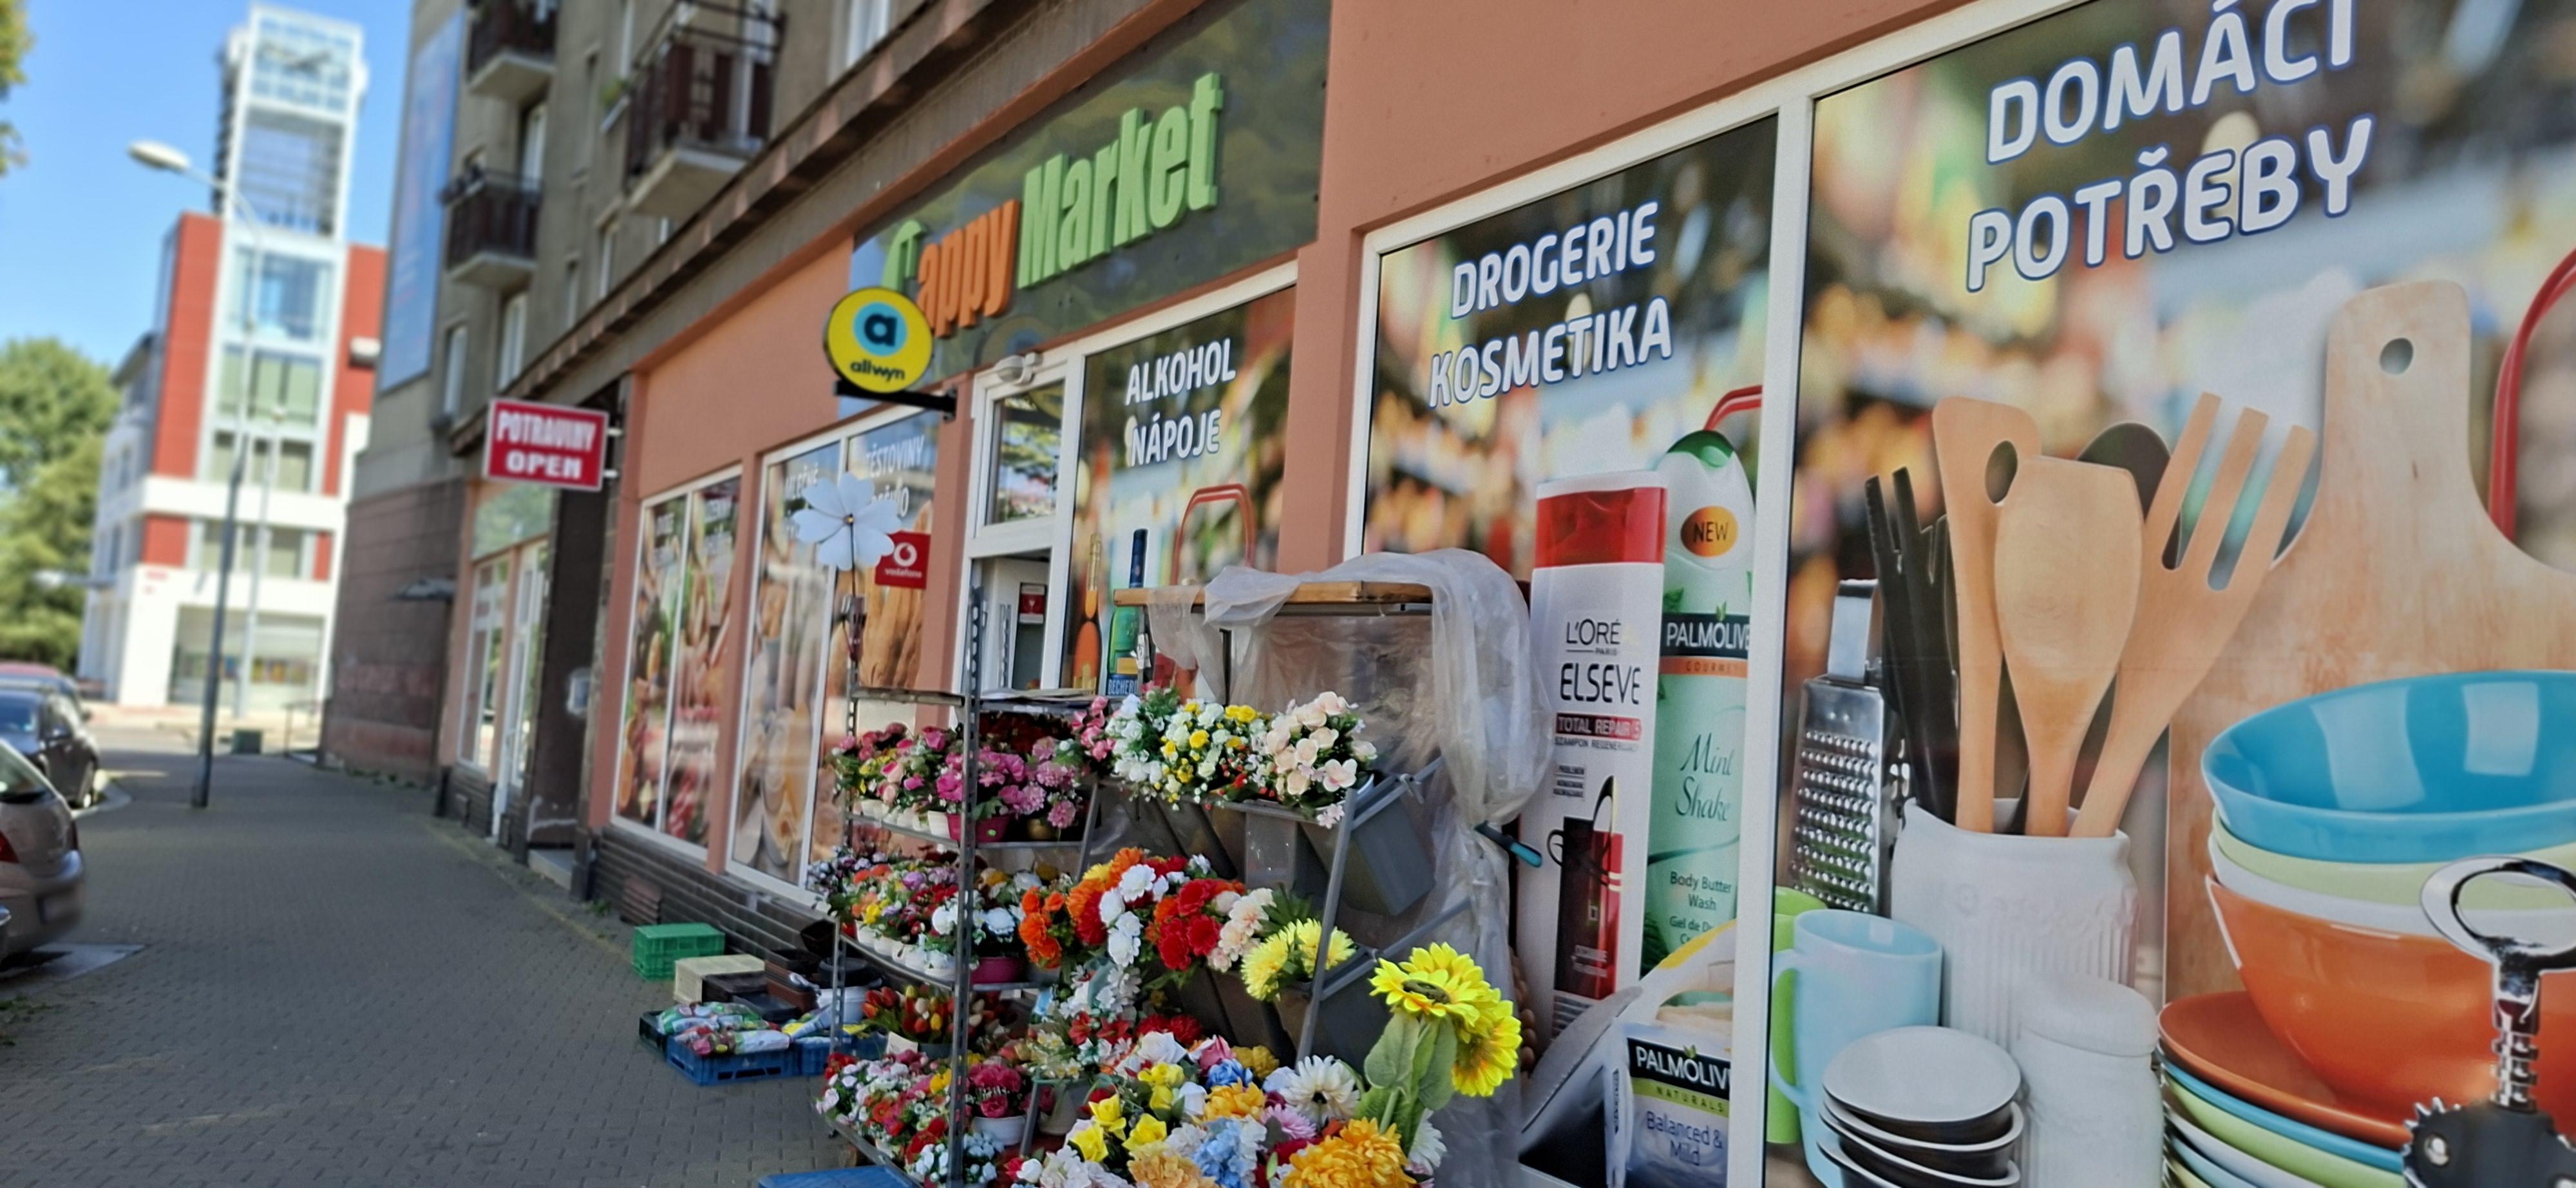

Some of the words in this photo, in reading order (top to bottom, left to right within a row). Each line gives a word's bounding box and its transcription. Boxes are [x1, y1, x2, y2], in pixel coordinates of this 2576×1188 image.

[1018, 71, 1224, 290] Market
[1967, 115, 2374, 292] POTŘEBY
[1452, 200, 1658, 320] DROGERIE
[850, 359, 905, 382] allwyn
[1124, 337, 1236, 407] ALKOHOL
[1428, 296, 1673, 409] KOSMETIKA
[1130, 408, 1222, 468] NÁPOJE
[506, 449, 583, 480] OPEN
[1693, 522, 1728, 542] NEW
[1560, 662, 1641, 705] ELSEVE
[1558, 716, 1592, 734] TOTAL
[1595, 719, 1631, 737] REPAIR
[1676, 776, 1731, 821] Shake
[1670, 871, 1699, 890] Body
[1701, 876, 1732, 894] Butter
[1689, 893, 1717, 910] Wash
[1669, 915, 1687, 928] Gel
[1688, 919, 1700, 931] de
[1636, 1046, 1730, 1089] PALMOLIV
[1656, 1086, 1723, 1113] NATURALS
[1646, 1110, 1710, 1145] Balanced
[1713, 1129, 1723, 1149] &
[1670, 1140, 1700, 1165] Mild
